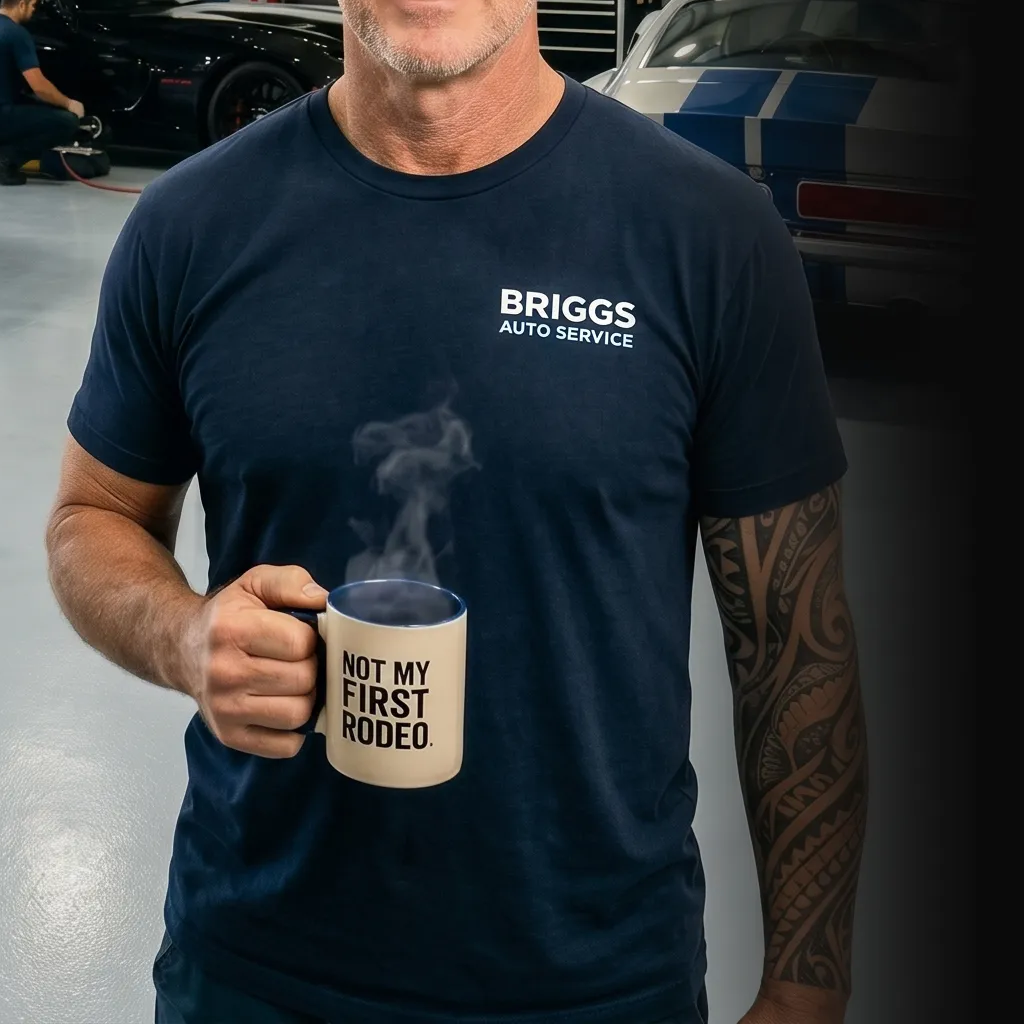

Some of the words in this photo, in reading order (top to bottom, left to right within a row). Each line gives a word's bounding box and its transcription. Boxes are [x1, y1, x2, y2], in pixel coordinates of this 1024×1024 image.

[500, 288, 636, 329] BRIGGS
[499, 320, 551, 338] AUTO
[555, 325, 634, 349] SERVICE
[342, 650, 386, 684] NOT
[394, 660, 430, 686] MY
[343, 677, 429, 719] FIRST
[342, 709, 433, 749] RODEO.
